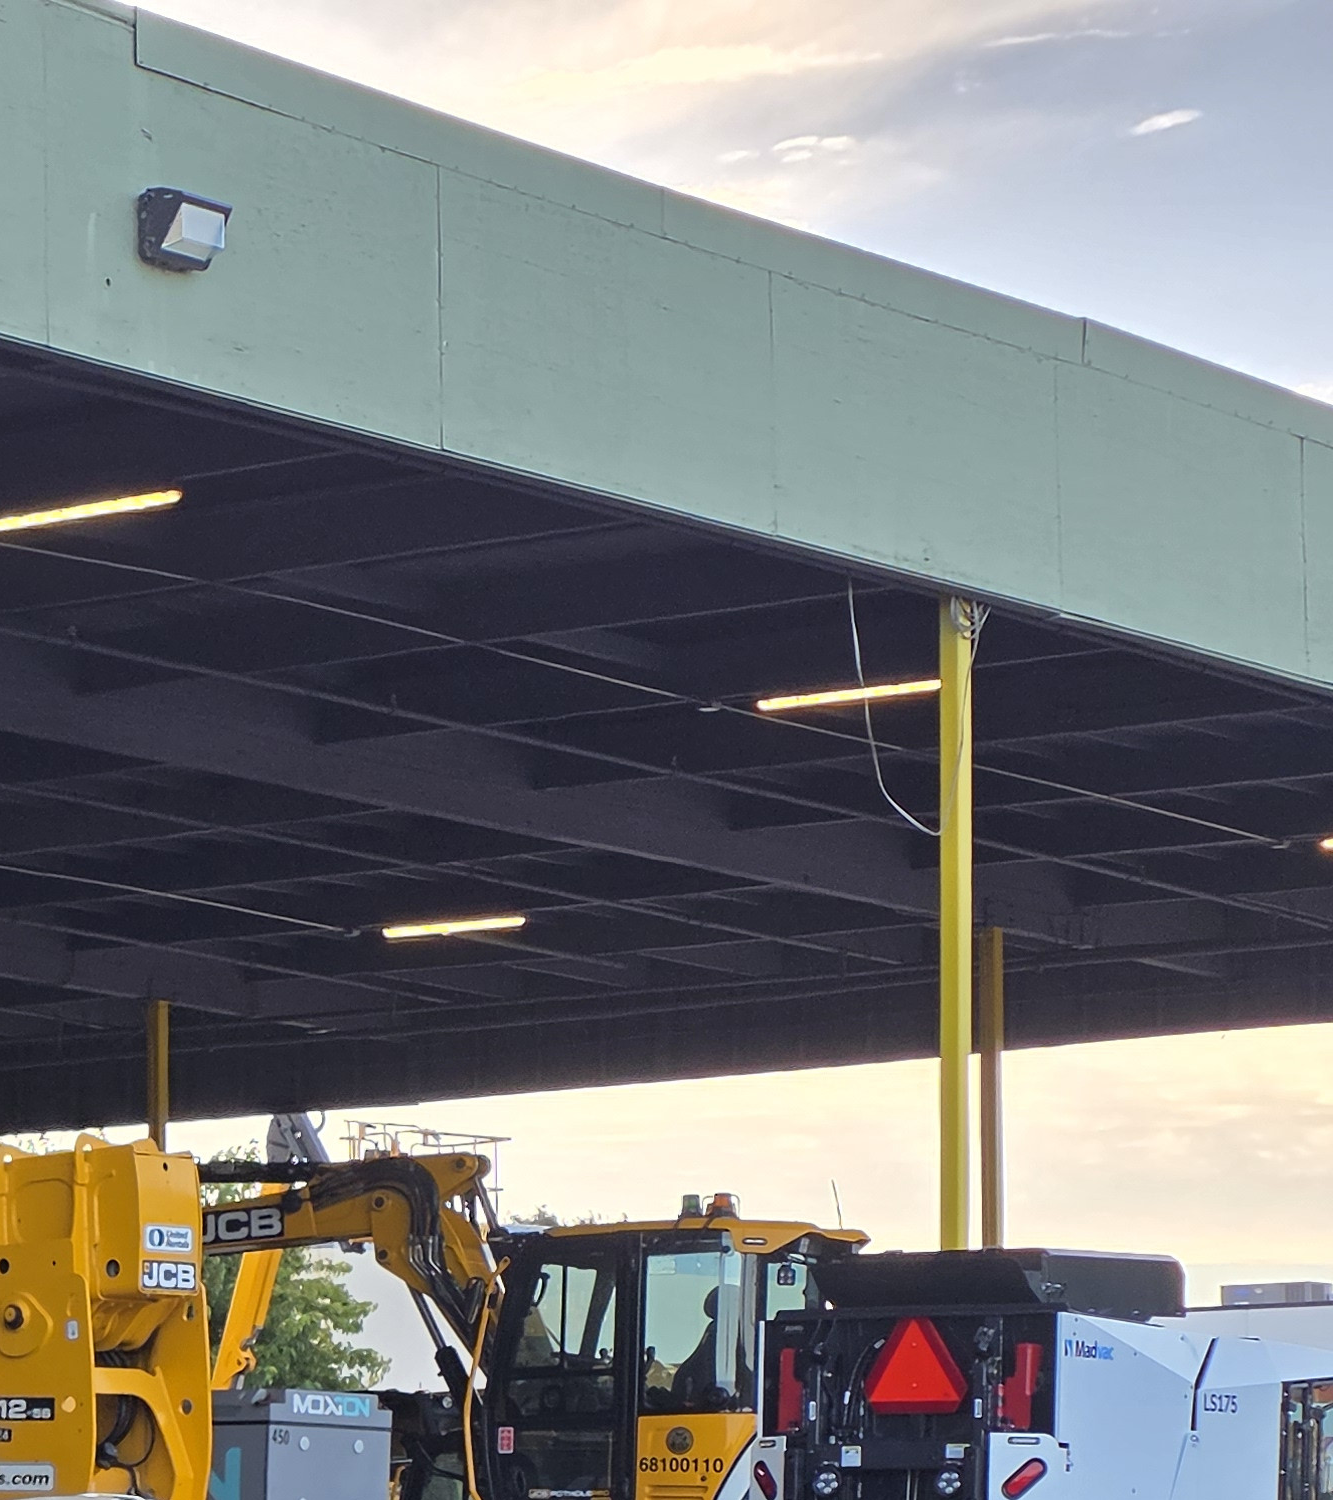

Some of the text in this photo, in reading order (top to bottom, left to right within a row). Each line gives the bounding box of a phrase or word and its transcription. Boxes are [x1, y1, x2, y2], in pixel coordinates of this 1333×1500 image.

[203, 1208, 282, 1243] JCB
[143, 1262, 195, 1288] JCB
[1203, 1393, 1237, 1413] LS175
[272, 1429, 290, 1446] 450
[639, 1457, 724, 1473] 68100110
